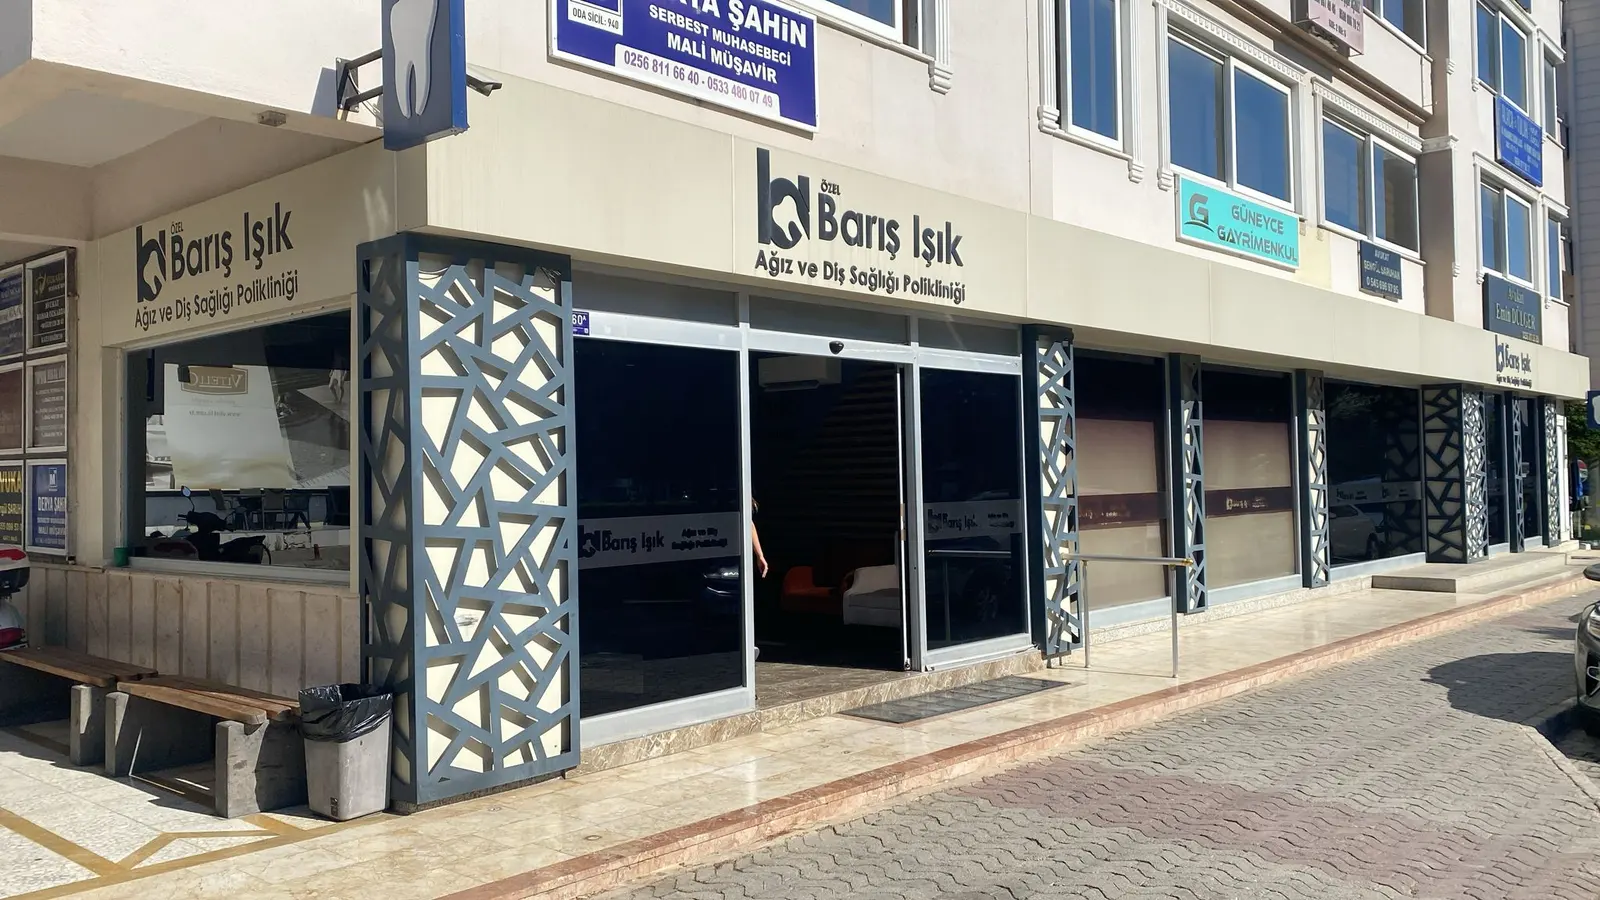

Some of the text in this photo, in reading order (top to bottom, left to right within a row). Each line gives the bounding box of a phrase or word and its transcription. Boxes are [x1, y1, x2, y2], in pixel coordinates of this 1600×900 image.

[572, 8, 586, 20] ODA
[608, 18, 619, 29] 940
[649, 4, 709, 37] SERBEST
[712, 28, 791, 66] MUHASEBECİ
[728, 0, 807, 48] ŞAHİN
[624, 50, 649, 71] 0256
[652, 57, 670, 77] 811
[673, 62, 685, 81] 66
[687, 67, 699, 85] 40
[707, 75, 729, 96] 0533
[732, 82, 747, 101] 480
[749, 88, 760, 105] 07
[762, 93, 773, 108] 49
[667, 31, 778, 84] MALİ MÜŞAVİR
[820, 179, 841, 195] ÖZEL
[170, 221, 184, 234] ÖZEL
[171, 202, 294, 281] Barış Işık
[818, 192, 963, 267] Barış Işık
[1217, 225, 1297, 261] GAYRİMENKUL
[1231, 204, 1284, 235] GÜNEYCE
[134, 269, 299, 331] Ağız ve Diş Sağlığı Polikliniği
[755, 249, 966, 305] Ağız ve Diş Sağlığı Polikliniği
[1496, 303, 1511, 322] Emin
[602, 530, 664, 553] Barış Işık
